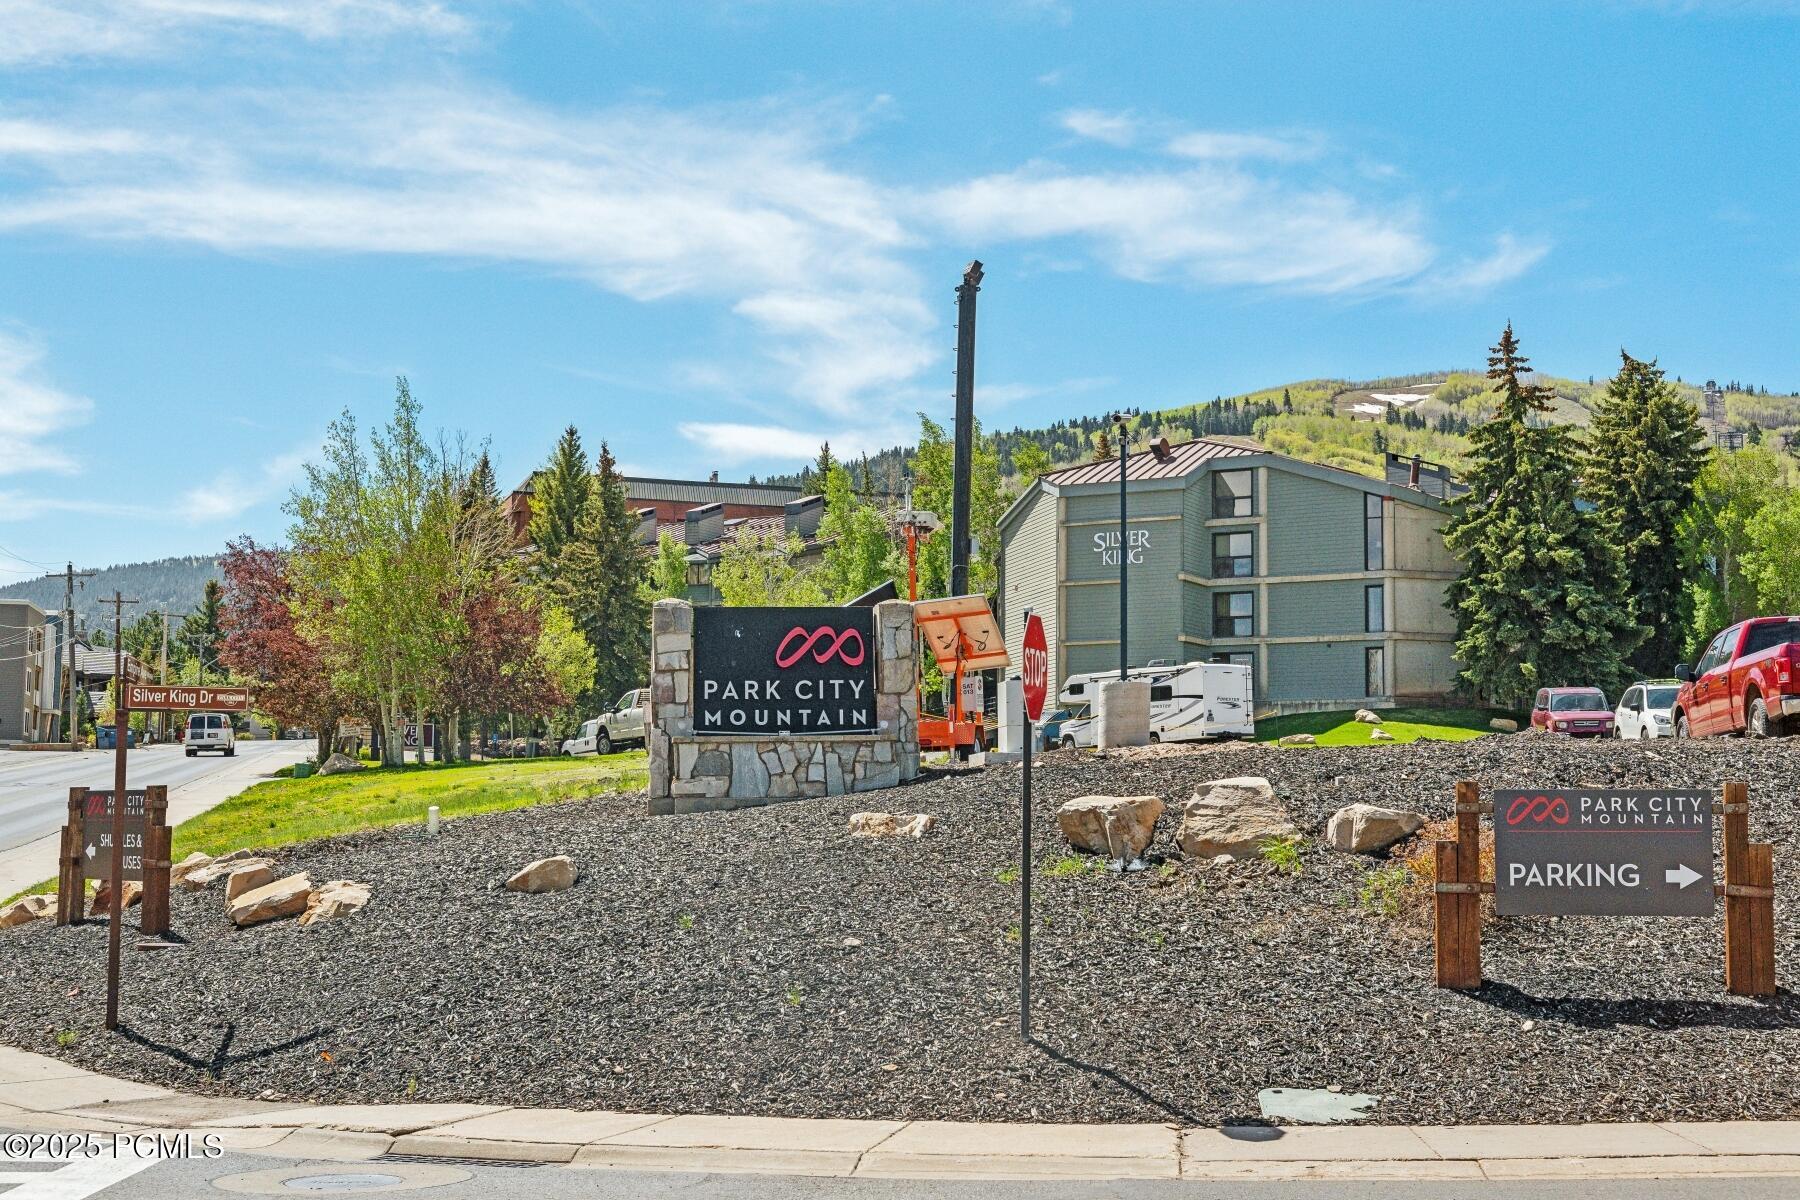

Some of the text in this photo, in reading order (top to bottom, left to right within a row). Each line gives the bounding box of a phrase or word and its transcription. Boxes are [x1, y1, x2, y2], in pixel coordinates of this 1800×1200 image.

[1102, 547, 1143, 566] KING
[1024, 646, 1047, 689] STOP
[132, 688, 167, 703] Silver
[169, 689, 197, 707] King
[199, 690, 214, 704] Dr
[704, 679, 865, 700] PARK CITY
[704, 709, 867, 726] MOUNTAIN
[127, 795, 145, 807] CITY
[1580, 797, 1702, 812] PARK CITY
[1581, 813, 1703, 824] MOUNTAIN
[100, 833, 143, 848] SHULES &
[1509, 863, 1640, 887] PARKING
